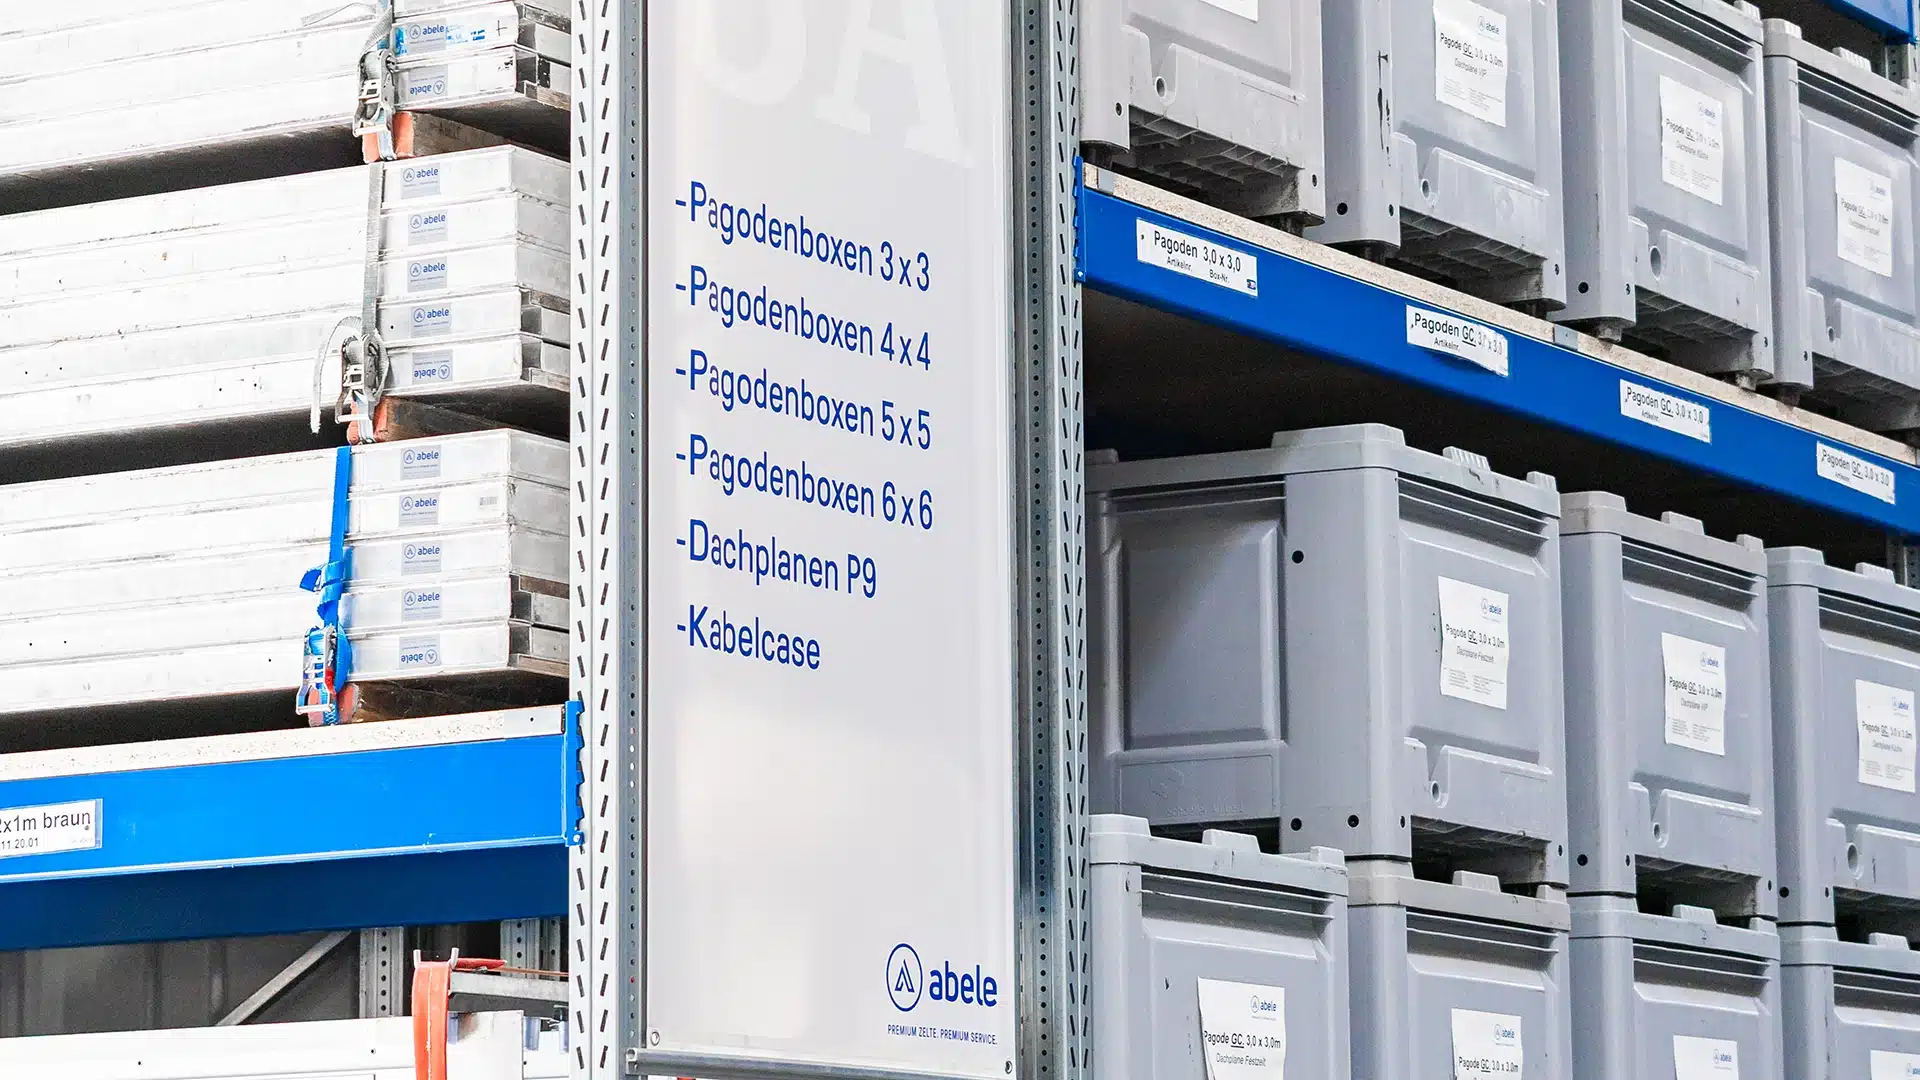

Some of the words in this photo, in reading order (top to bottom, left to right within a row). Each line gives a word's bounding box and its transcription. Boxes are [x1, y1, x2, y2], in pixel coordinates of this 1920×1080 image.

[422, 24, 444, 35] abele
[1440, 32, 1461, 50] Pagode
[410, 84, 432, 96] abele
[416, 168, 438, 178] abele
[424, 214, 446, 224] abele
[675, 181, 872, 276] -Pagodenboxen
[880, 241, 894, 281] 3
[899, 256, 912, 287] x
[916, 252, 930, 291] 3
[1154, 230, 1198, 258] Pagoden
[1203, 246, 1217, 266] 3,0
[1220, 254, 1224, 267] x
[1227, 254, 1241, 273] 3,0
[423, 262, 445, 272] abele
[1209, 269, 1230, 283] Box-Nr.
[427, 308, 449, 318] abele
[675, 265, 873, 356] -Pagodenboxen
[880, 322, 895, 361] 4
[900, 336, 912, 367] x
[916, 332, 931, 371] 4
[1414, 312, 1460, 337] Pagoden
[414, 368, 436, 378] abele
[675, 349, 874, 436] -Pagodenboxen
[882, 400, 895, 442] 5
[900, 415, 912, 447] x
[918, 409, 931, 450] 5
[1627, 386, 1658, 408] Pagoden
[1688, 410, 1692, 420] x
[416, 451, 439, 460] abele
[1822, 449, 1850, 471] Pagoden
[676, 433, 874, 518] -Pagodenboxen
[882, 481, 896, 522] 6
[901, 495, 914, 526] x
[919, 490, 933, 530] 6
[415, 498, 437, 507] abele
[418, 546, 440, 555] abele
[676, 518, 838, 591] -Dachplanen
[848, 554, 876, 598] P9
[417, 592, 440, 602] abele
[677, 604, 821, 670] -Kabelcase
[1446, 624, 1466, 639] Pagode
[401, 653, 423, 663] abele
[1669, 676, 1687, 692] Pagode
[0, 815, 36, 833] x1m
[43, 812, 91, 829] braun
[929, 960, 998, 1007] abele
[1260, 1000, 1276, 1011] abele
[887, 1024, 917, 1036] PREMIUM
[919, 1026, 939, 1038] ZELTE.
[940, 1028, 969, 1041] PREMIUM
[971, 1032, 998, 1045] SERVICE.
[1204, 1030, 1229, 1045] Pagode
[1246, 1034, 1256, 1047] 3,0
[1264, 1037, 1280, 1049] 3,0m
[1216, 1052, 1244, 1064] Dachplane
[1459, 1056, 1479, 1070] Pagode
